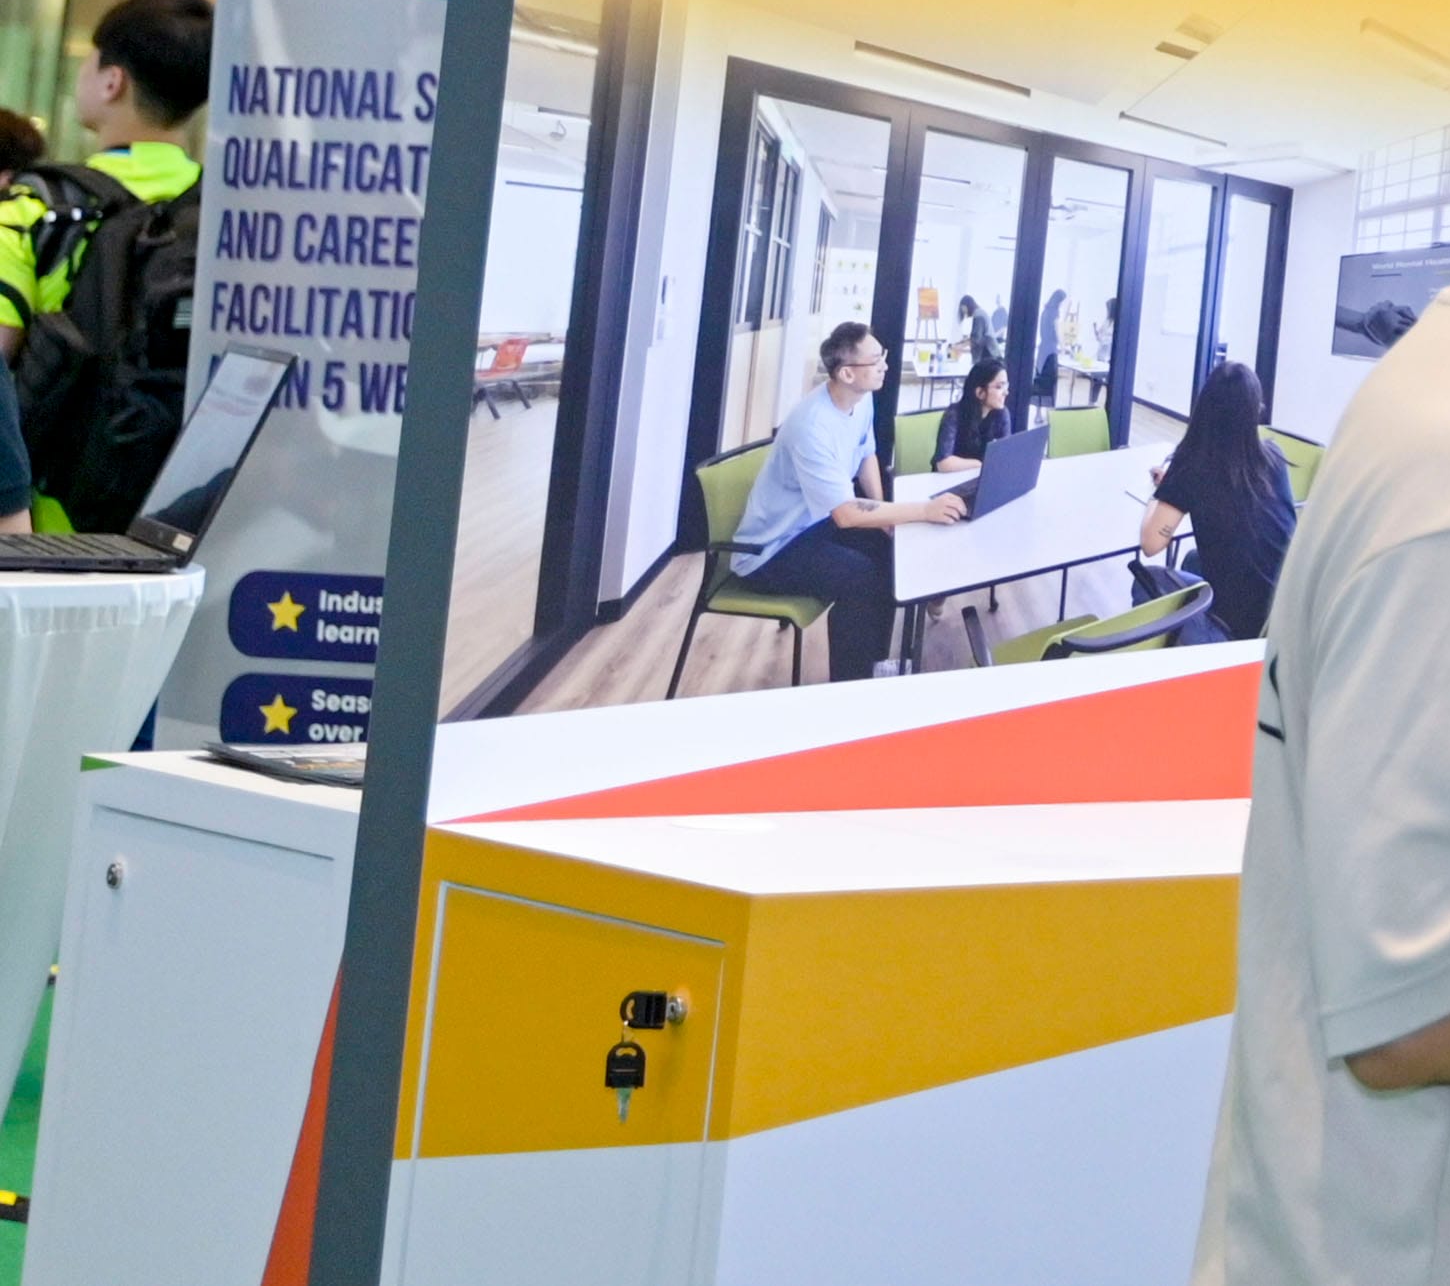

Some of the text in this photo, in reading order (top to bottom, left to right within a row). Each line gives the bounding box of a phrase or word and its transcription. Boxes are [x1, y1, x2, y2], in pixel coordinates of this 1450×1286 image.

[228, 64, 401, 120] NATIONAL
[215, 209, 417, 268] AND CAREE
[322, 361, 345, 411] 5
[311, 689, 372, 714] Seas
[308, 723, 364, 743] over
